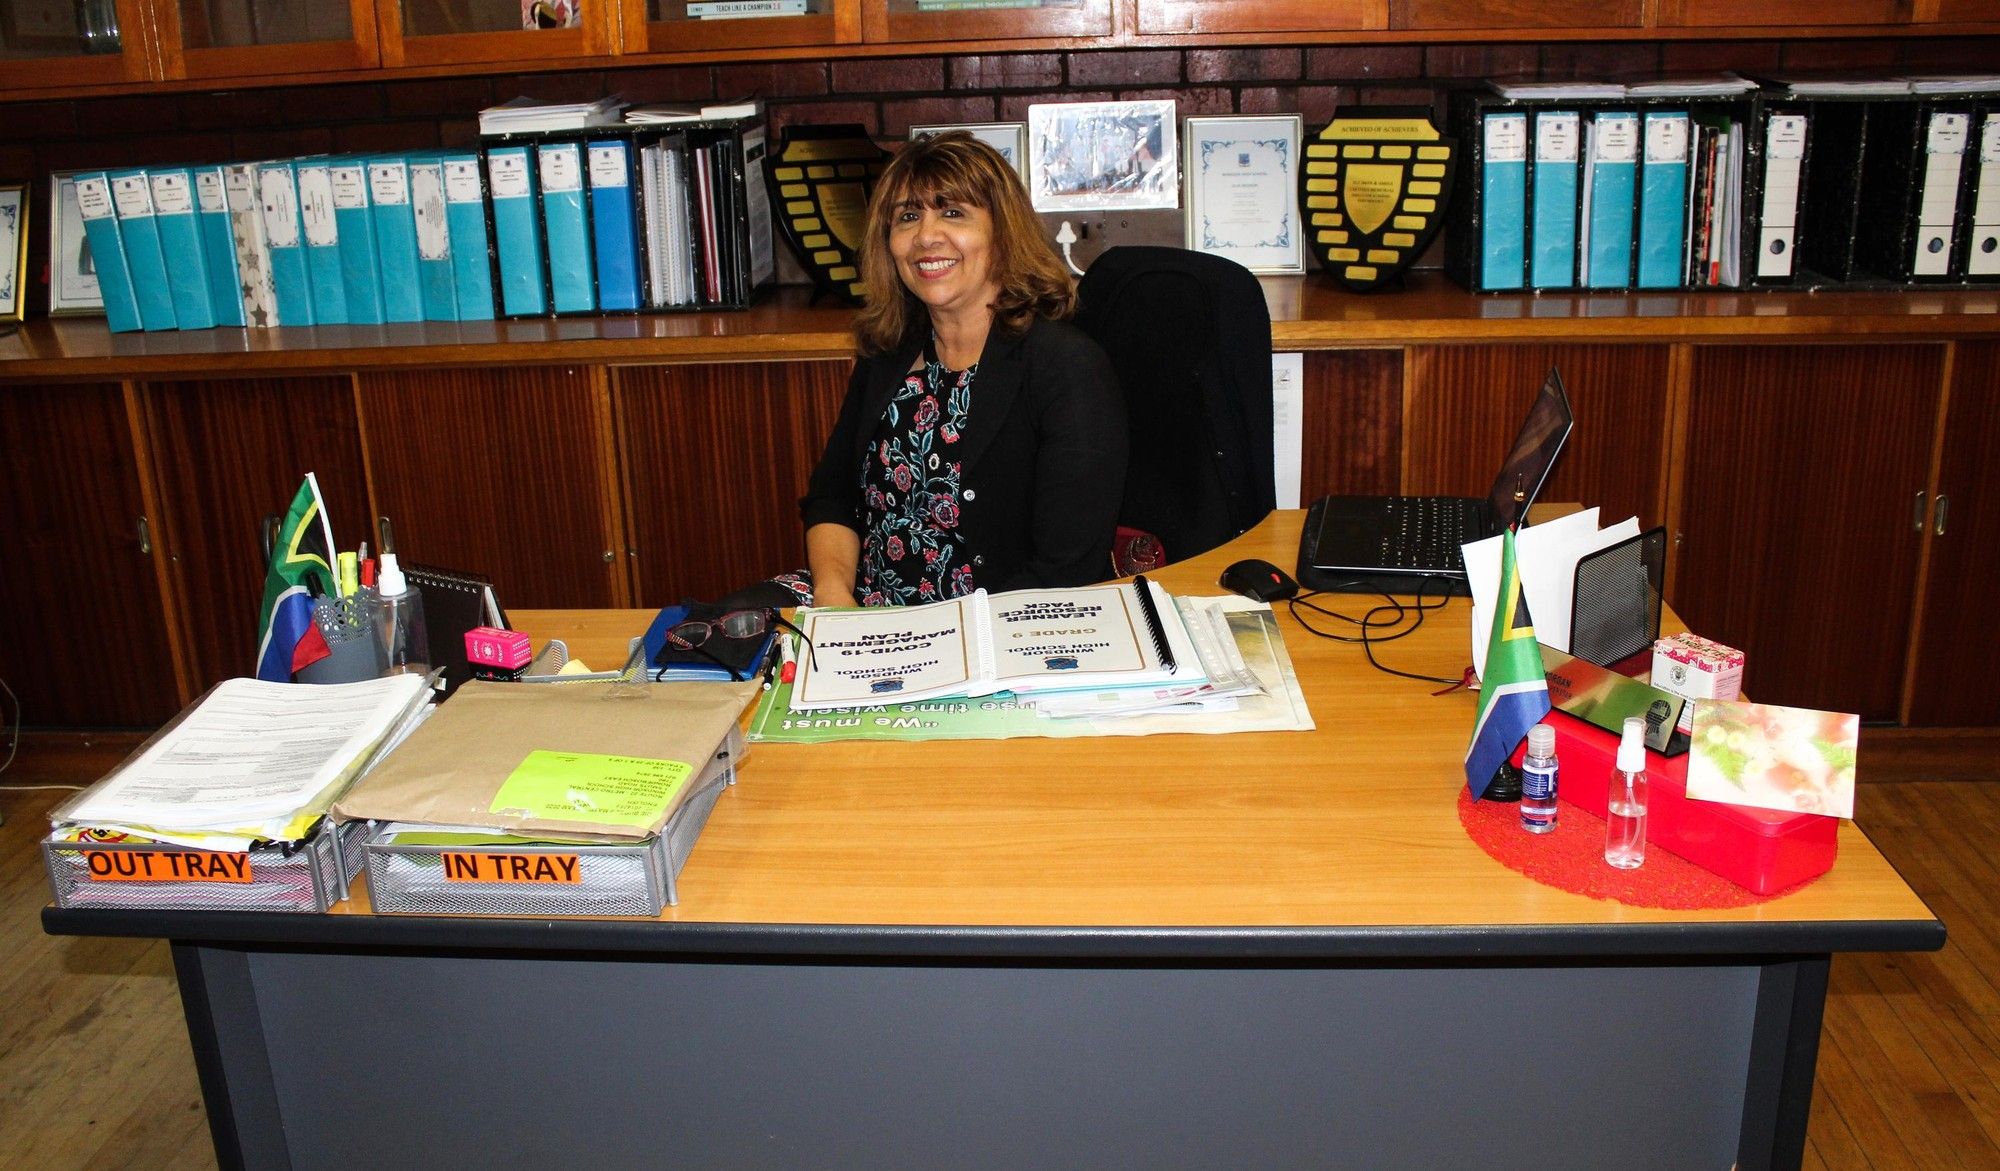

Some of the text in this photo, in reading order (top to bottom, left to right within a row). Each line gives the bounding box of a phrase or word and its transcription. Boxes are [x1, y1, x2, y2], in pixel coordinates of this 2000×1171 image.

[997, 606, 1102, 618] RESOURCE
[1006, 612, 1097, 623] LEARNER
[816, 628, 956, 648] MANAGEMENT
[861, 631, 913, 640] PLAN
[1030, 628, 1097, 636] GRADE
[841, 642, 932, 656] COVID-19
[1004, 645, 1066, 653] SCHOOL
[1023, 648, 1094, 656] WINDSOR
[833, 660, 938, 675] HIGH SCHOOL
[850, 668, 922, 679] WINDSOR
[900, 702, 968, 714] time
[781, 718, 862, 731] must
[87, 851, 247, 879] OUT TRAY
[443, 853, 577, 881] IN TRAY
